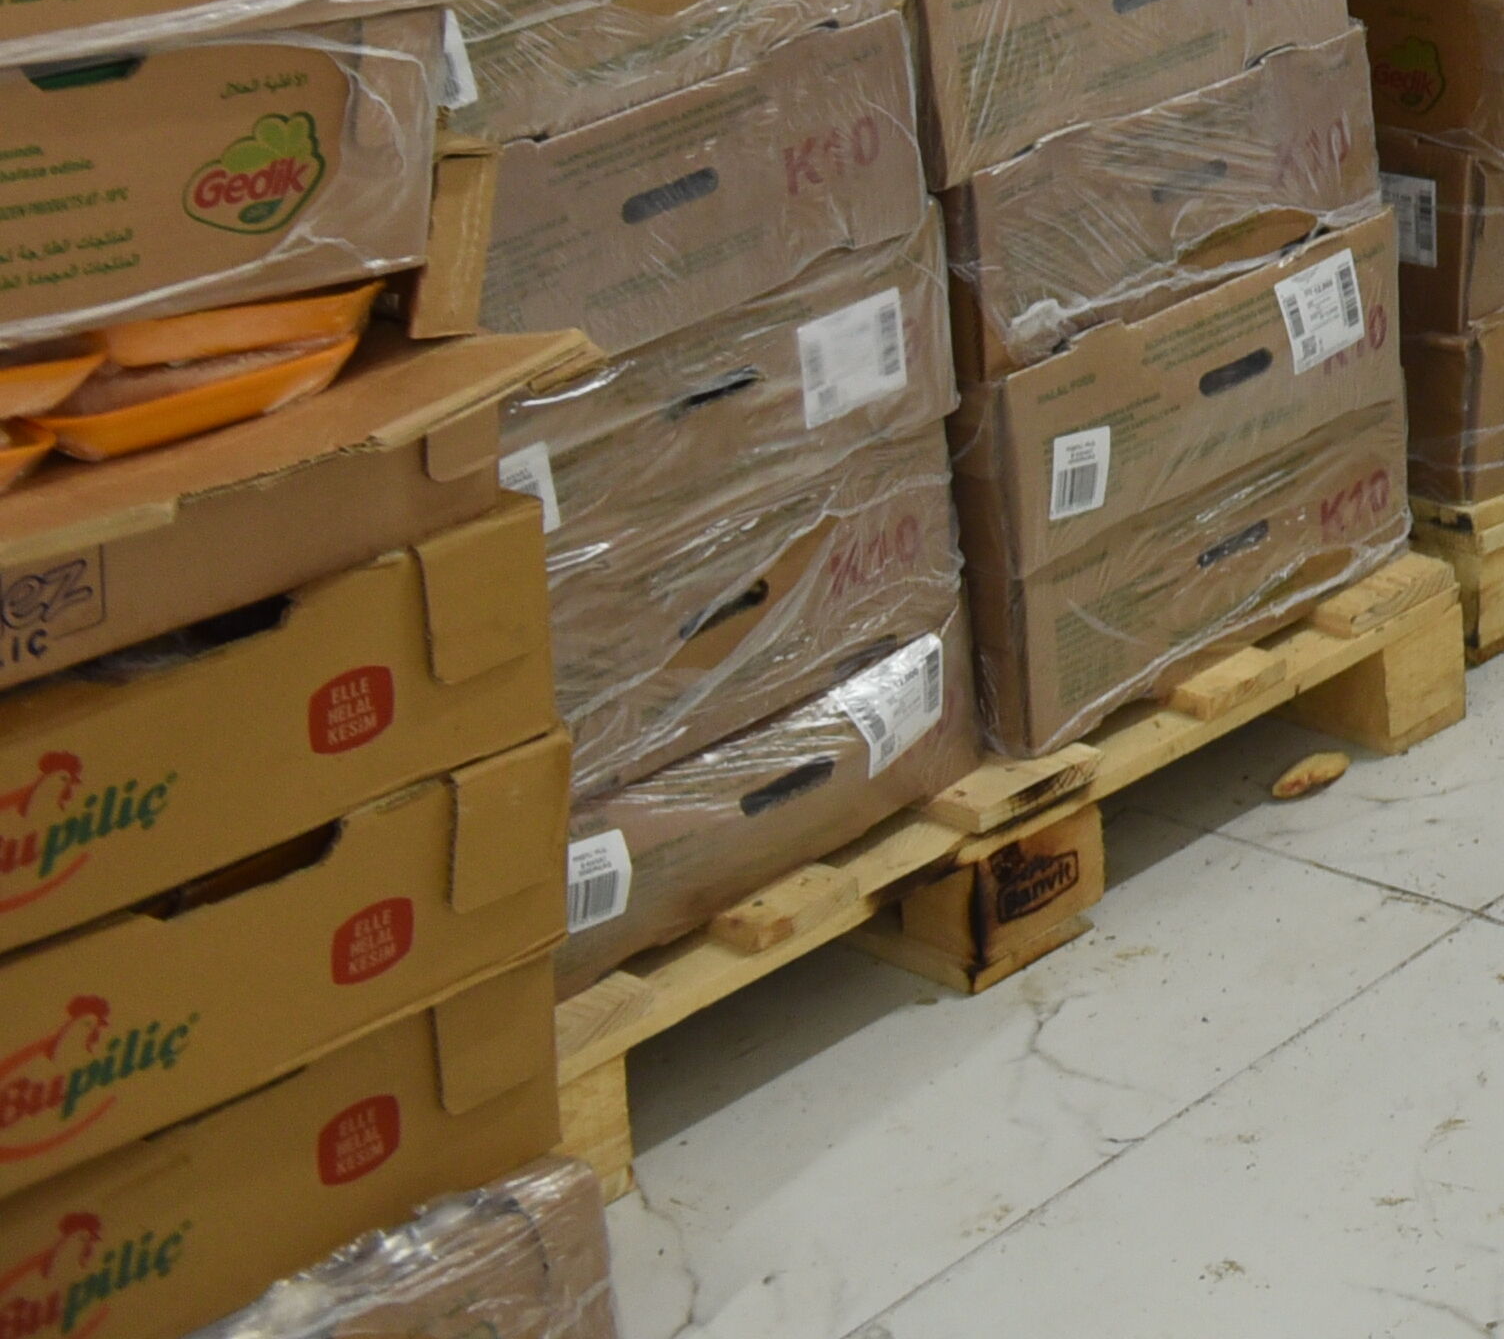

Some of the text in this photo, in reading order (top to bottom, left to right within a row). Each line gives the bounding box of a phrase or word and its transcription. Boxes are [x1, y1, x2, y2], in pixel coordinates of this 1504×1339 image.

[783, 116, 880, 196] K10
[193, 157, 308, 209] Gedik
[1320, 468, 1391, 545] K10
[331, 677, 371, 706] ELLE
[327, 694, 375, 726] HELAL
[0, 778, 170, 880] upiliç
[354, 907, 393, 931] ELLE
[350, 925, 395, 955] HELAL
[339, 1107, 377, 1135] ELLE
[336, 1125, 381, 1156] HELAL
